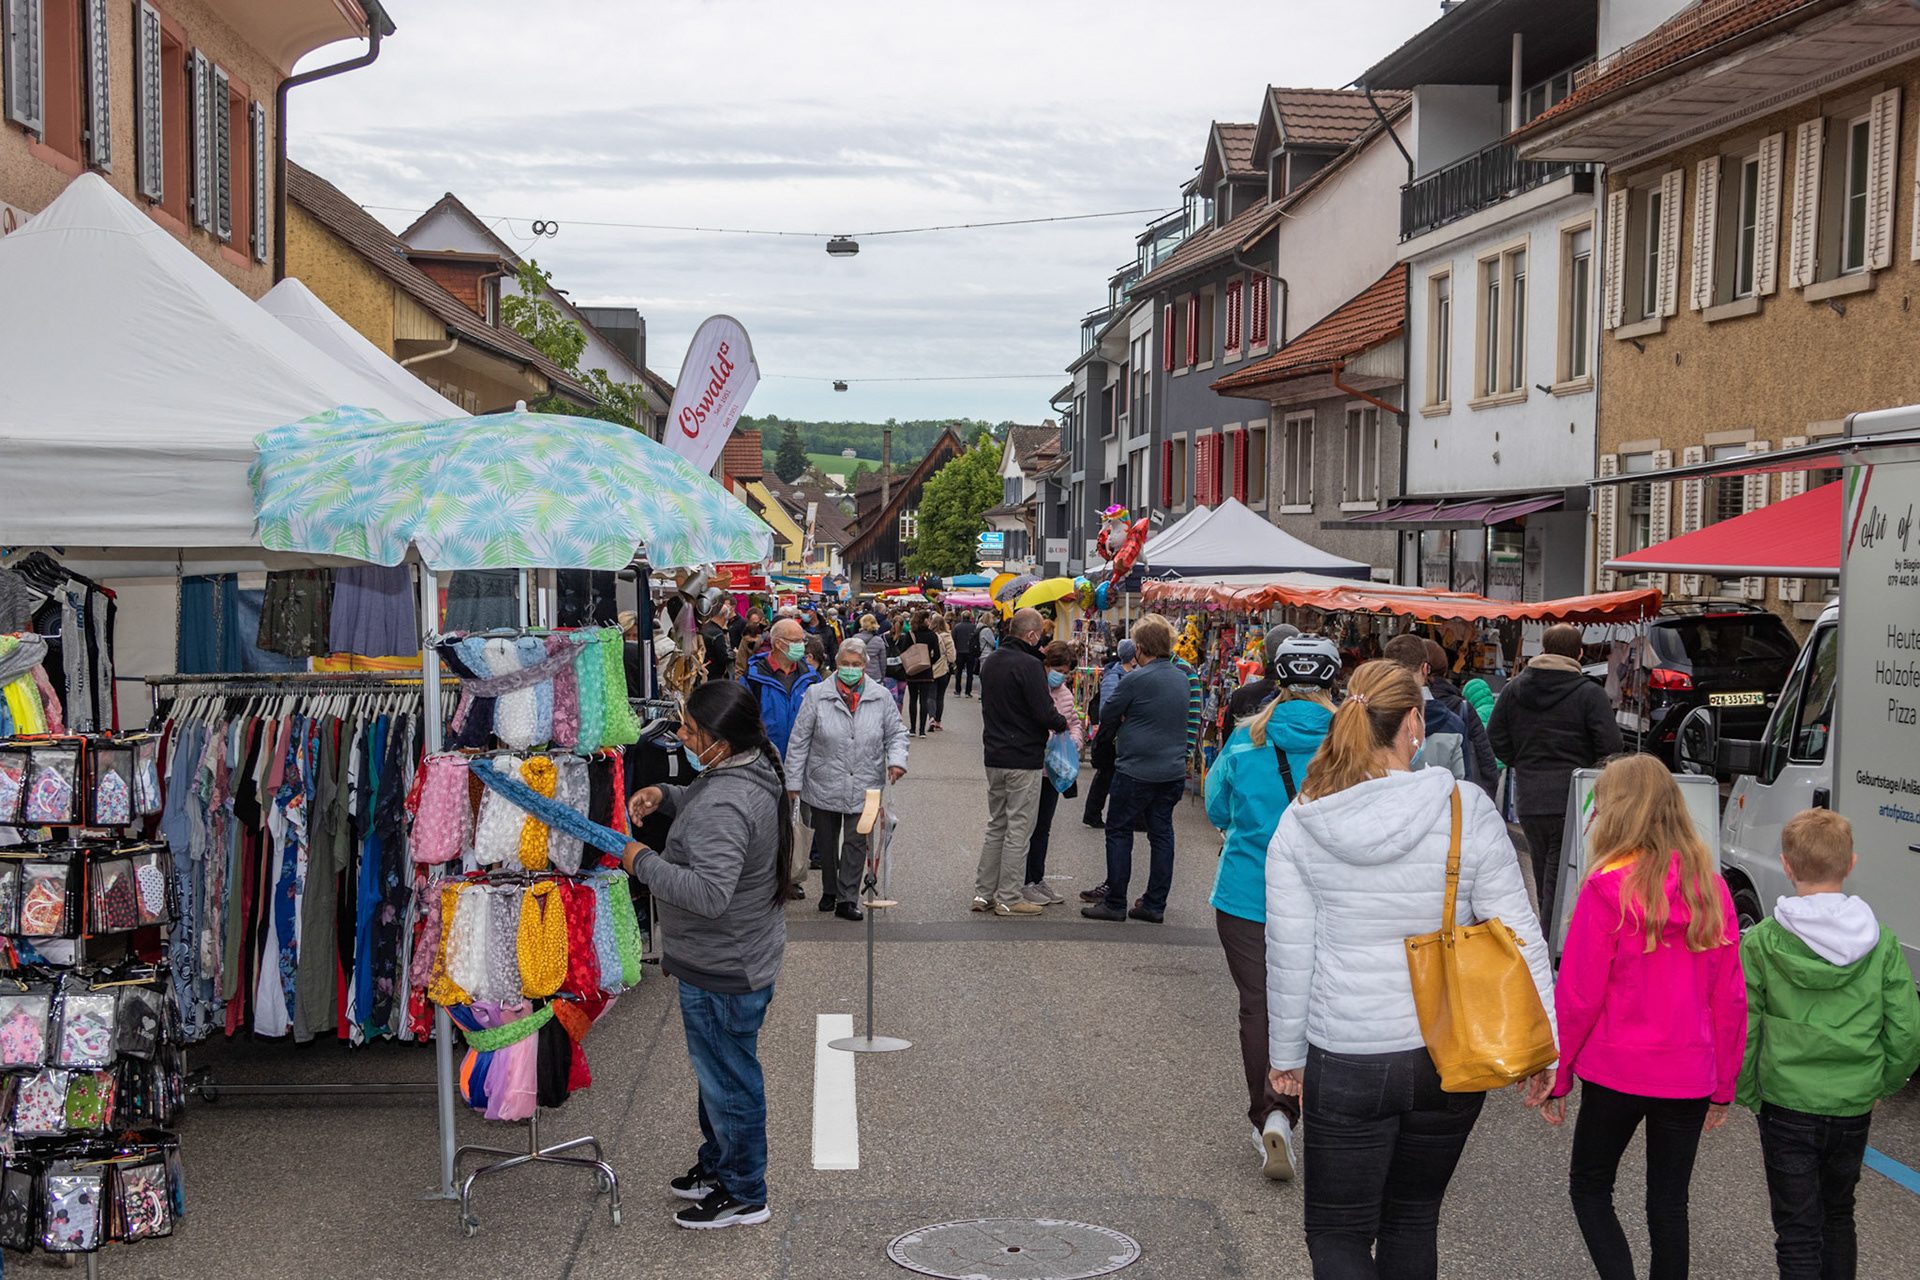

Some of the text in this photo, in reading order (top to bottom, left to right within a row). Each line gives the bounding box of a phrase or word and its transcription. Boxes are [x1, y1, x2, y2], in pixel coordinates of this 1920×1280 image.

[678, 352, 734, 439] Oswald
[713, 389, 731, 416] Seit 1951
[722, 404, 739, 428] Seit 1951
[1861, 503, 1913, 552] Art of
[1895, 559, 1902, 573] by
[1900, 575, 1910, 586] 442
[1911, 575, 1918, 586] 04
[1887, 624, 1920, 650] Heute
[1876, 660, 1920, 687] Holzofe
[1888, 698, 1916, 725] Pizza
